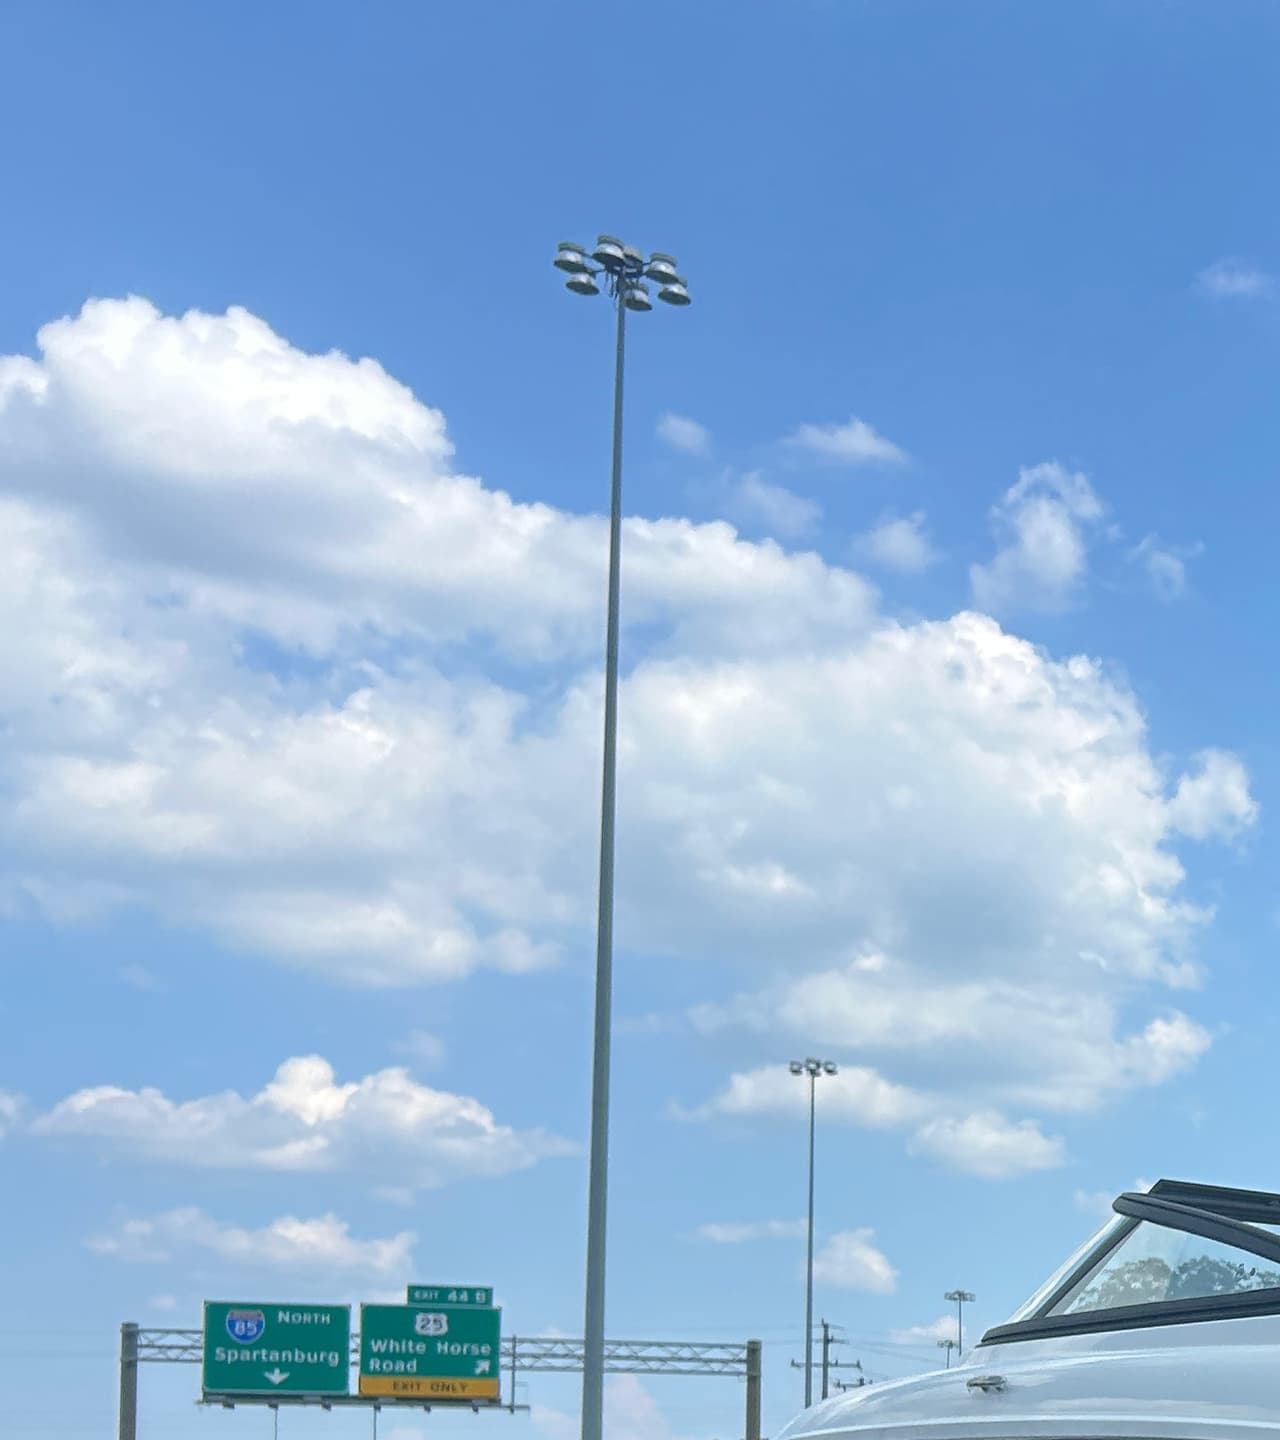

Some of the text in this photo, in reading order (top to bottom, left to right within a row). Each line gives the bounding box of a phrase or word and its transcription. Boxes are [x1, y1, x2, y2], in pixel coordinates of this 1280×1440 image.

[414, 1290, 440, 1300] EXIT
[447, 1290, 469, 1302] 44
[235, 1319, 257, 1336] 85
[420, 1316, 443, 1331] 25
[370, 1338, 492, 1356] White Horse
[214, 1347, 339, 1367] Spartanburg
[369, 1358, 417, 1373] Road
[392, 1381, 468, 1393] EXIT ONLY
